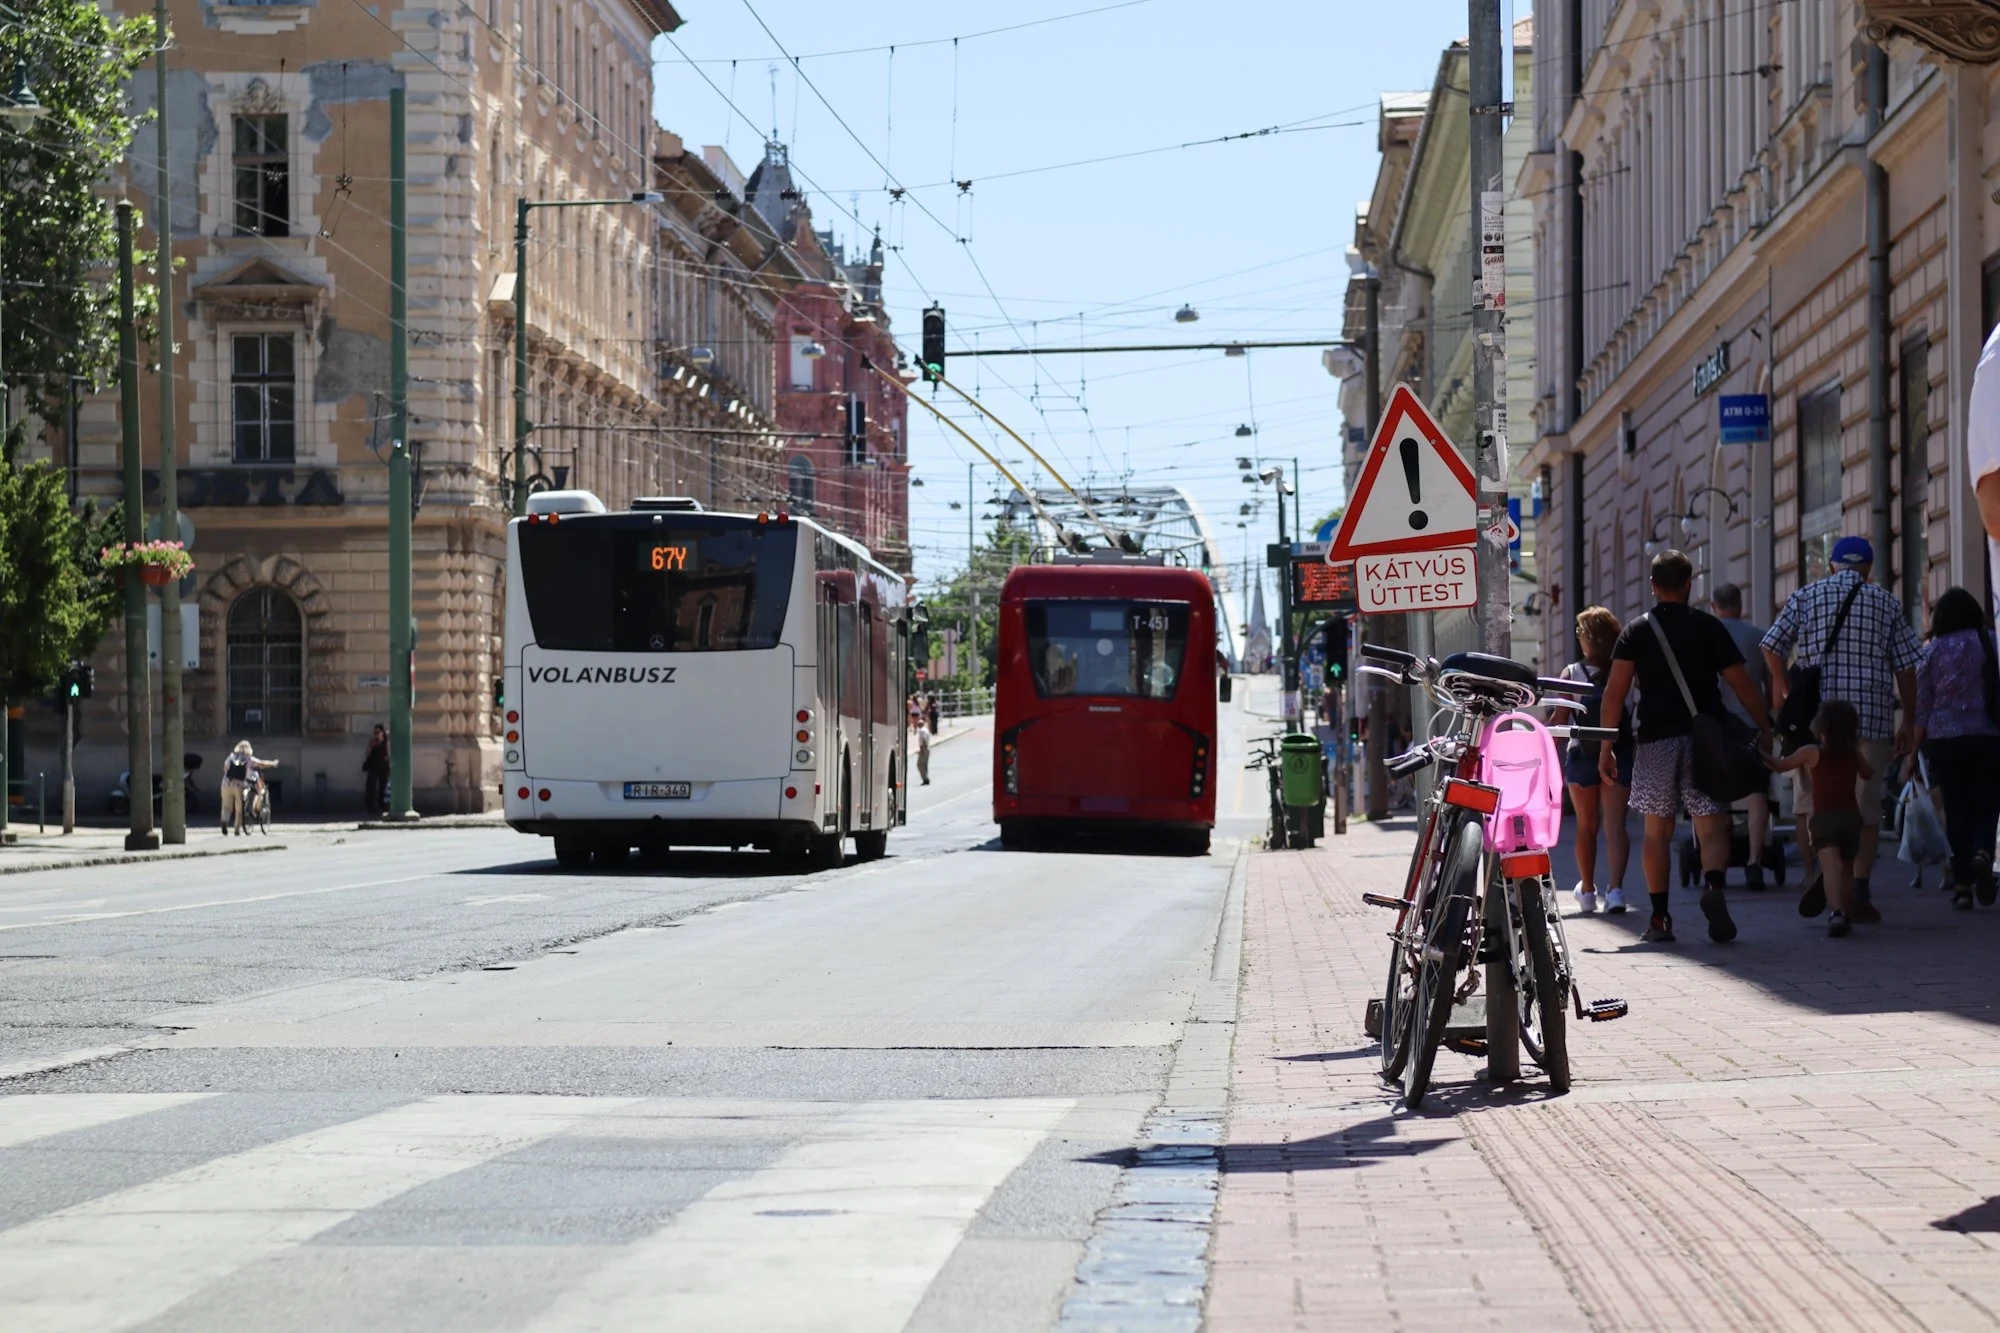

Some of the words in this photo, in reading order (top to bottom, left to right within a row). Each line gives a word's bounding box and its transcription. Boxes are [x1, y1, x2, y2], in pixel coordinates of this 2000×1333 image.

[652, 547, 687, 570] 67Y
[1365, 554, 1466, 582] KÁTYÚS
[1370, 582, 1463, 605] ÚTTEST
[1133, 615, 1169, 631] T-451
[528, 666, 678, 683] VOLÁNBUSZ
[633, 785, 687, 796] RIR-349
